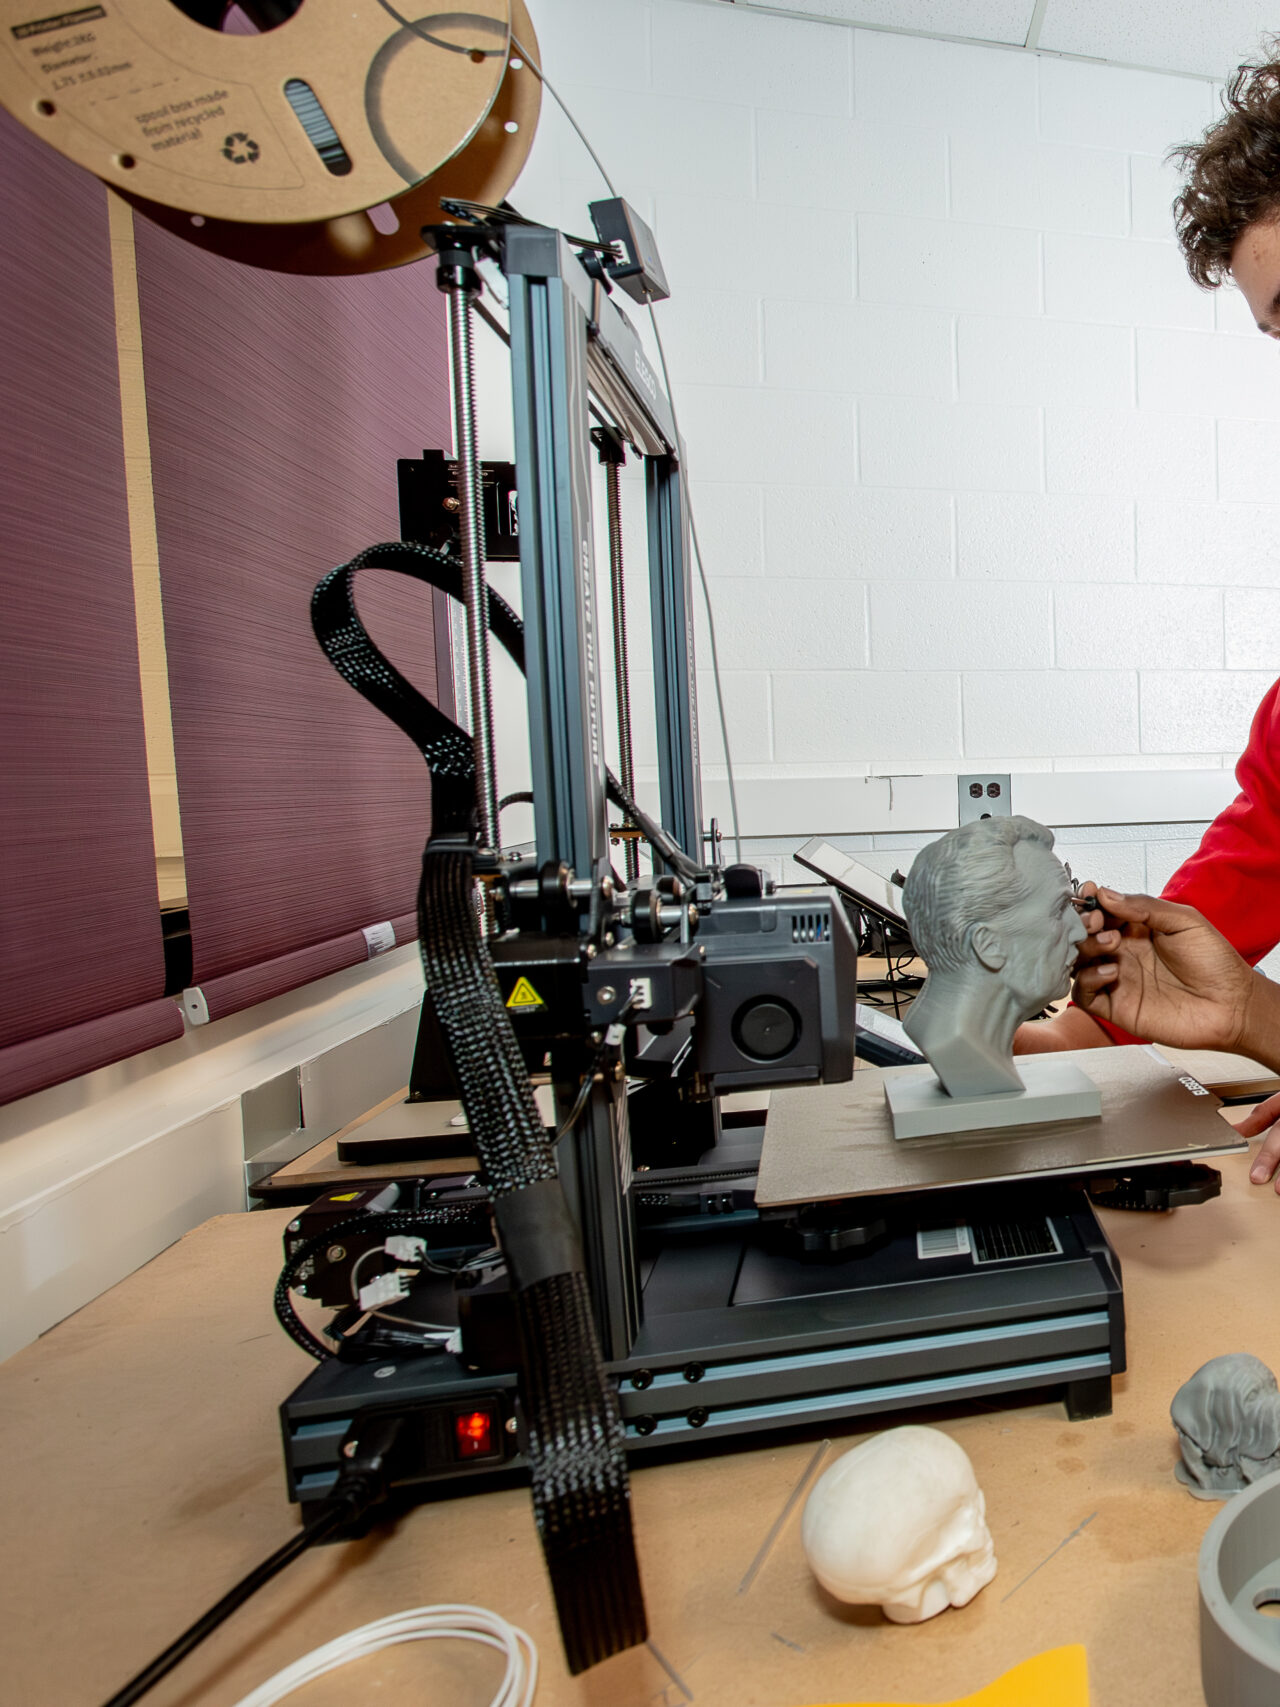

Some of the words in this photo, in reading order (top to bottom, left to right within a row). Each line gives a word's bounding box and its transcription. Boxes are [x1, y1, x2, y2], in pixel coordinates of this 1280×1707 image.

[169, 101, 193, 114] box
[194, 90, 228, 106] made
[142, 122, 174, 137] from
[174, 105, 225, 127] recycled
[151, 127, 202, 151] material
[582, 540, 592, 624] CREATE
[586, 632, 594, 673] THE
[589, 681, 599, 766] FUTURE
